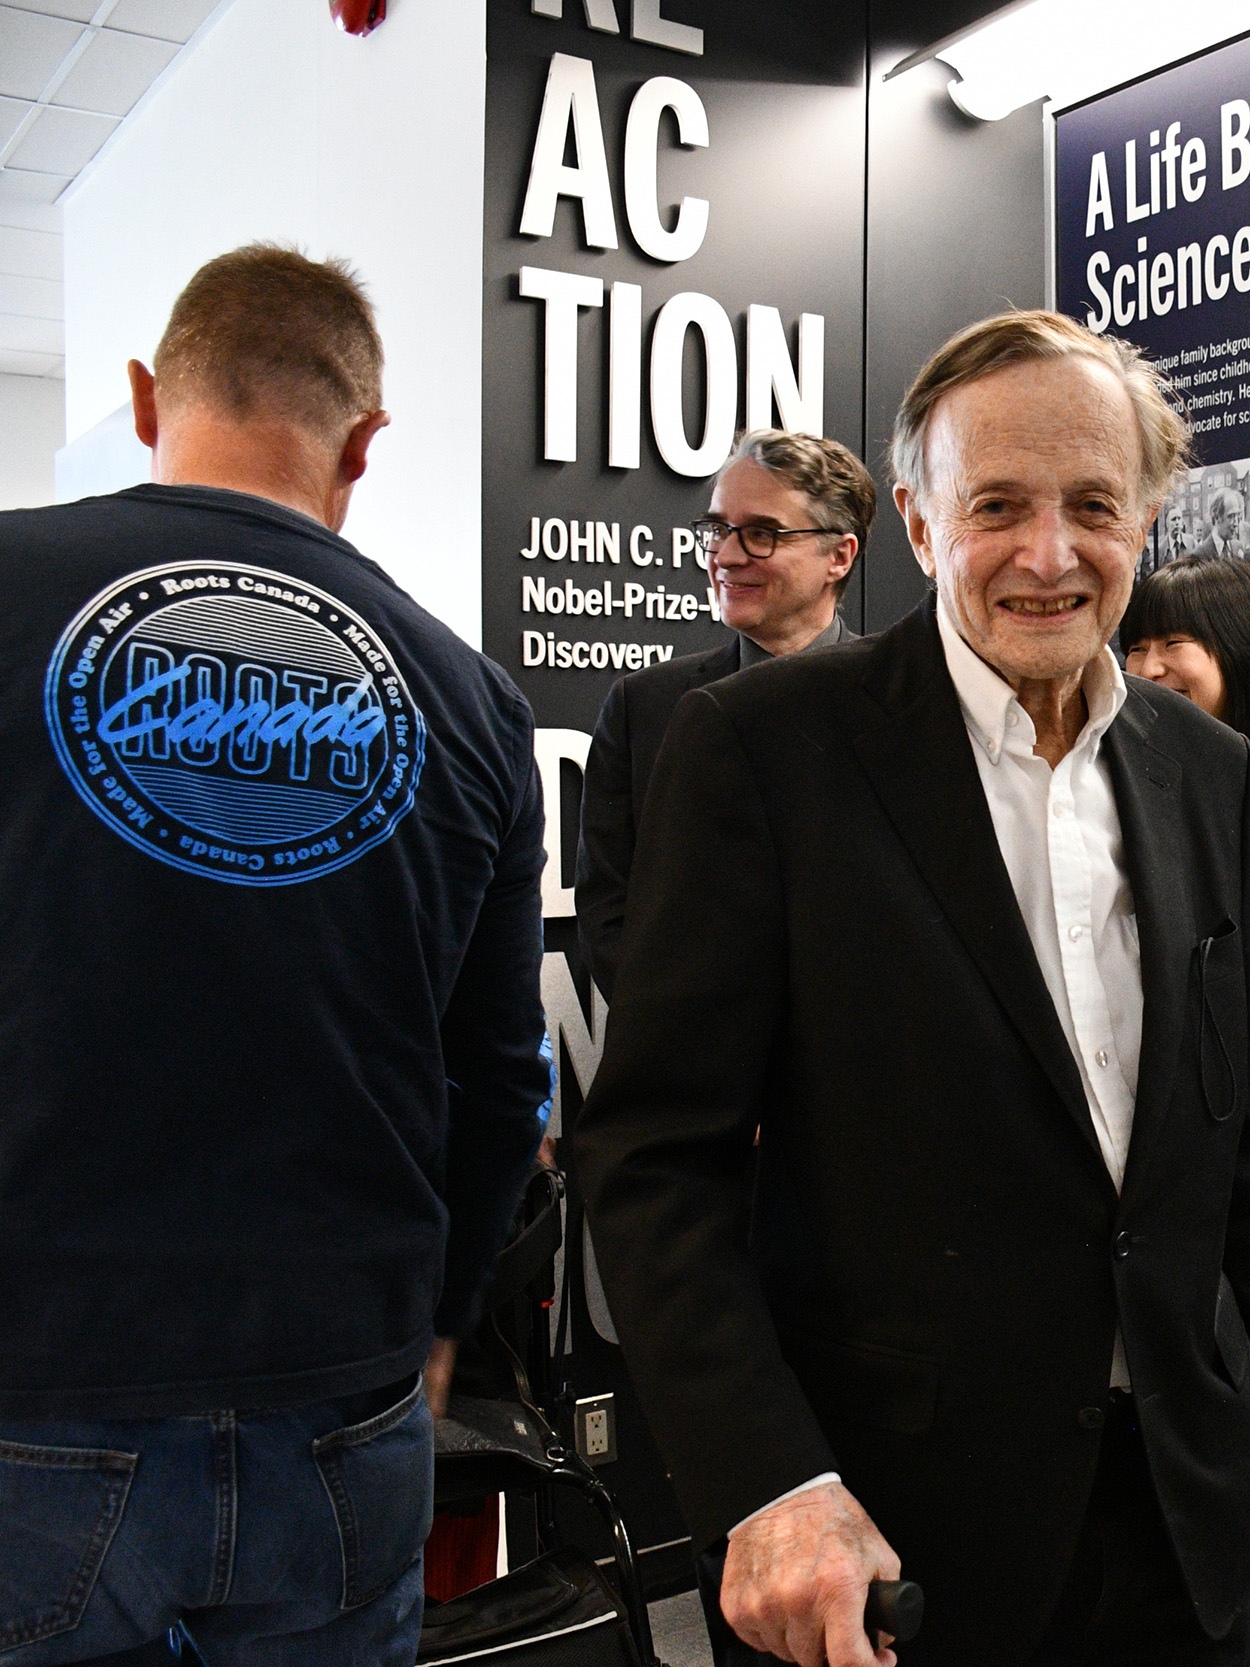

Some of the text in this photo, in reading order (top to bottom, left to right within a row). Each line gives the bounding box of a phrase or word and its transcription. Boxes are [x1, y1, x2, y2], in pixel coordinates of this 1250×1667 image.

[519, 52, 710, 262] AC
[1085, 151, 1114, 238] A
[1125, 121, 1207, 224] Life
[519, 265, 825, 478] TION
[1174, 374, 1192, 390] him
[1193, 369, 1218, 386] since
[1181, 345, 1209, 365] family
[1187, 389, 1236, 411] chemistry.
[1223, 411, 1237, 427] for
[519, 516, 620, 564] JOHN
[629, 524, 664, 567] C.
[160, 575, 321, 614] Roots Canada
[68, 602, 154, 829] Made for the Open Air
[97, 664, 387, 748] Canada
[121, 642, 372, 790] ROOTS
[343, 624, 409, 829] Made for the Open Air
[179, 835, 342, 871] Roots Canada
